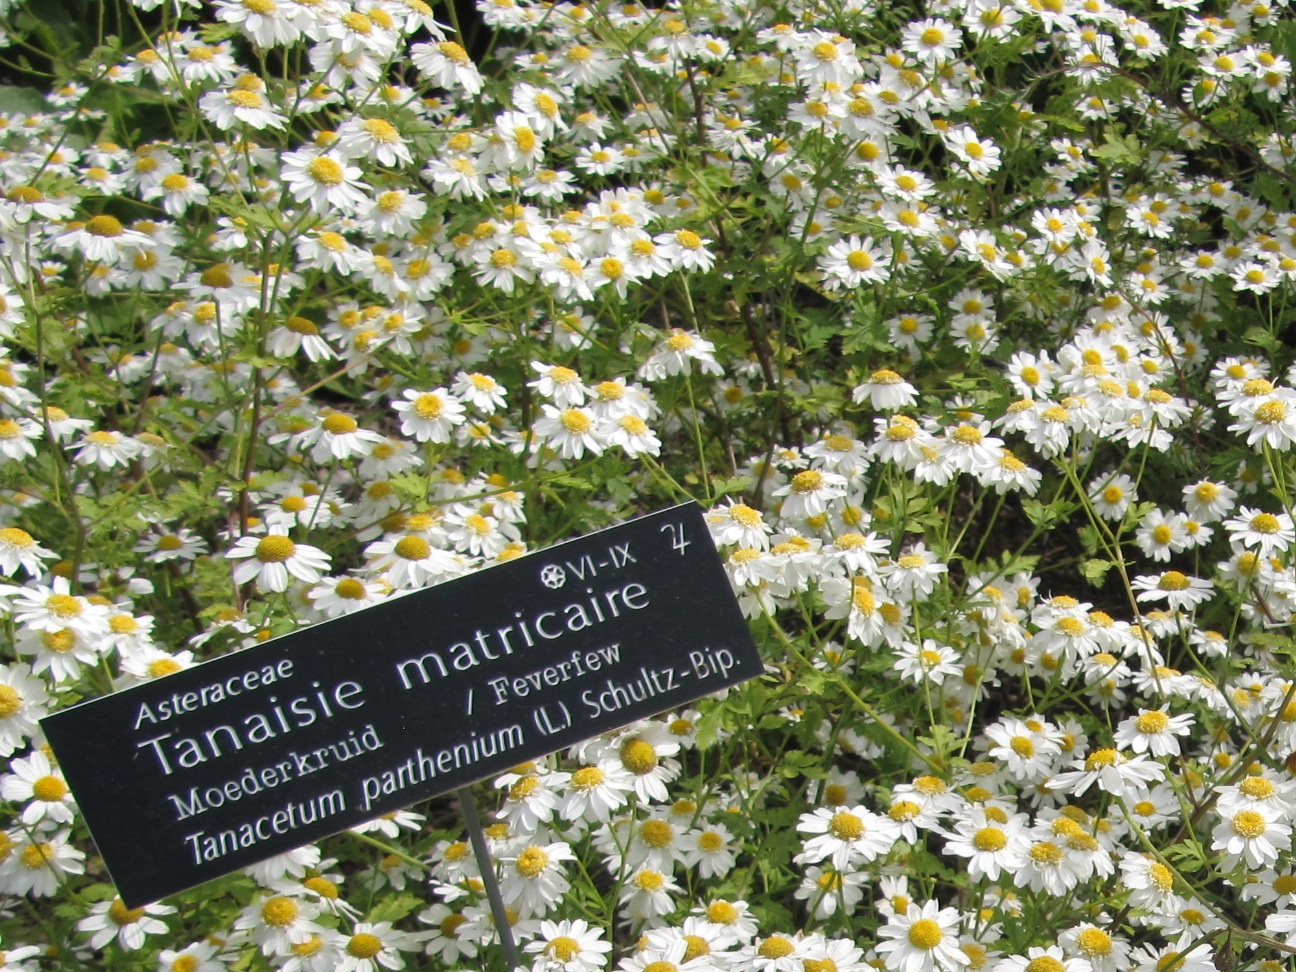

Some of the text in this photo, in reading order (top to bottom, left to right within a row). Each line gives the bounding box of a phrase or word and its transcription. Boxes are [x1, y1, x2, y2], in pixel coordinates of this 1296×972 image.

[566, 542, 637, 582] VI-IX
[133, 658, 295, 730] Asteraceae
[137, 582, 650, 776] Tanaisie matricaire
[168, 724, 384, 821] Moederkruid
[487, 643, 622, 706] Feverfew
[184, 646, 742, 865] Tanacetum parthenium (L.) Schultz-Bip.
